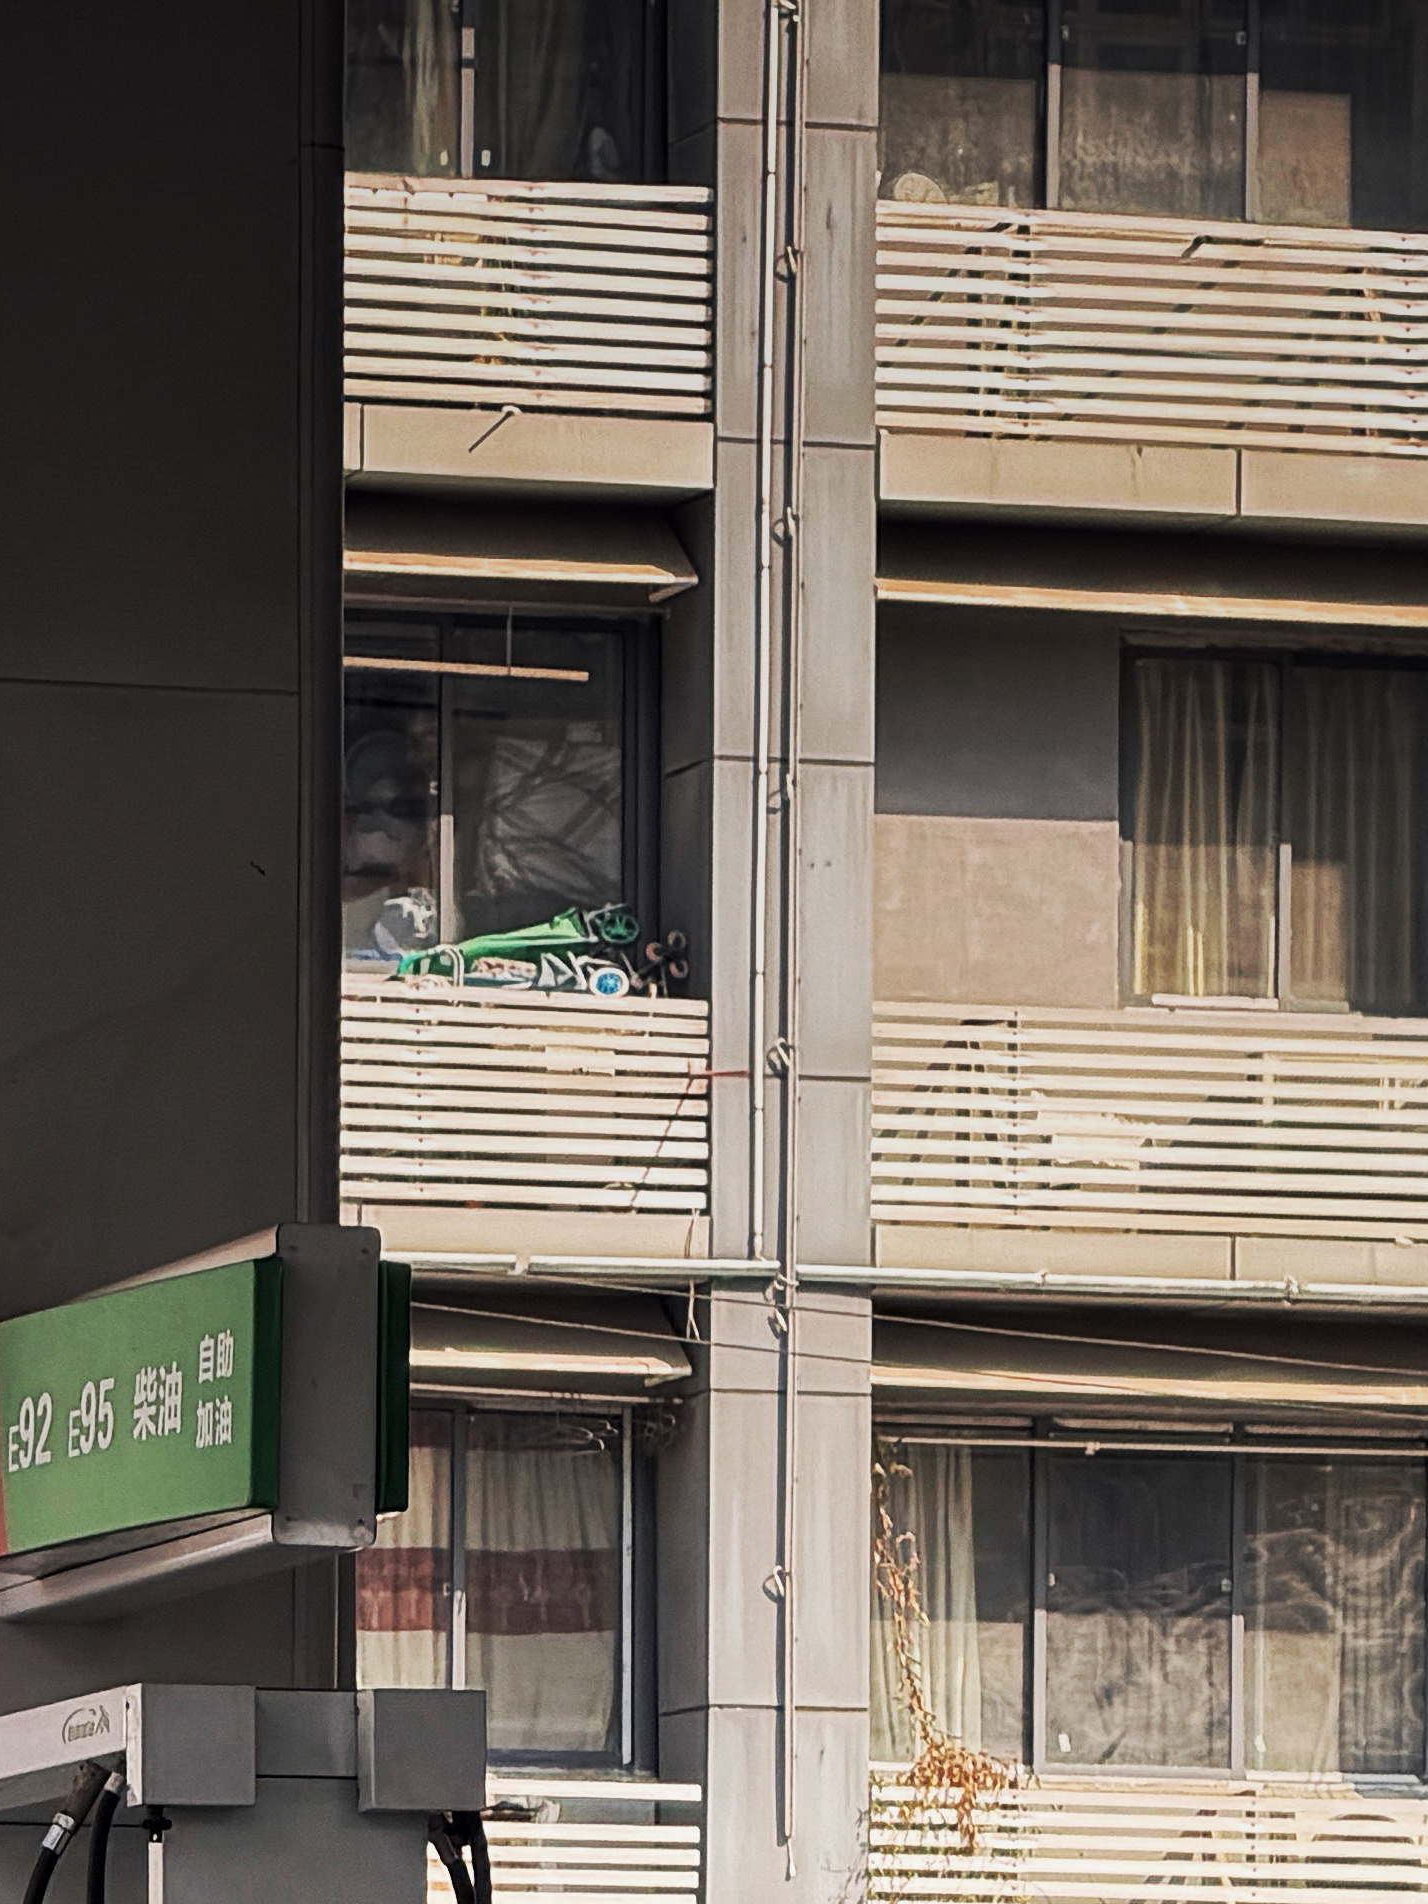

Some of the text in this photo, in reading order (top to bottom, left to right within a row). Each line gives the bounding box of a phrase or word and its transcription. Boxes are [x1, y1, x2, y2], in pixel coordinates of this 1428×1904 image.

[198, 1329, 234, 1384] 自助
[8, 1392, 53, 1473] E92
[68, 1377, 115, 1458] E95
[133, 1361, 183, 1441] 柴油
[195, 1394, 233, 1449] 加油
